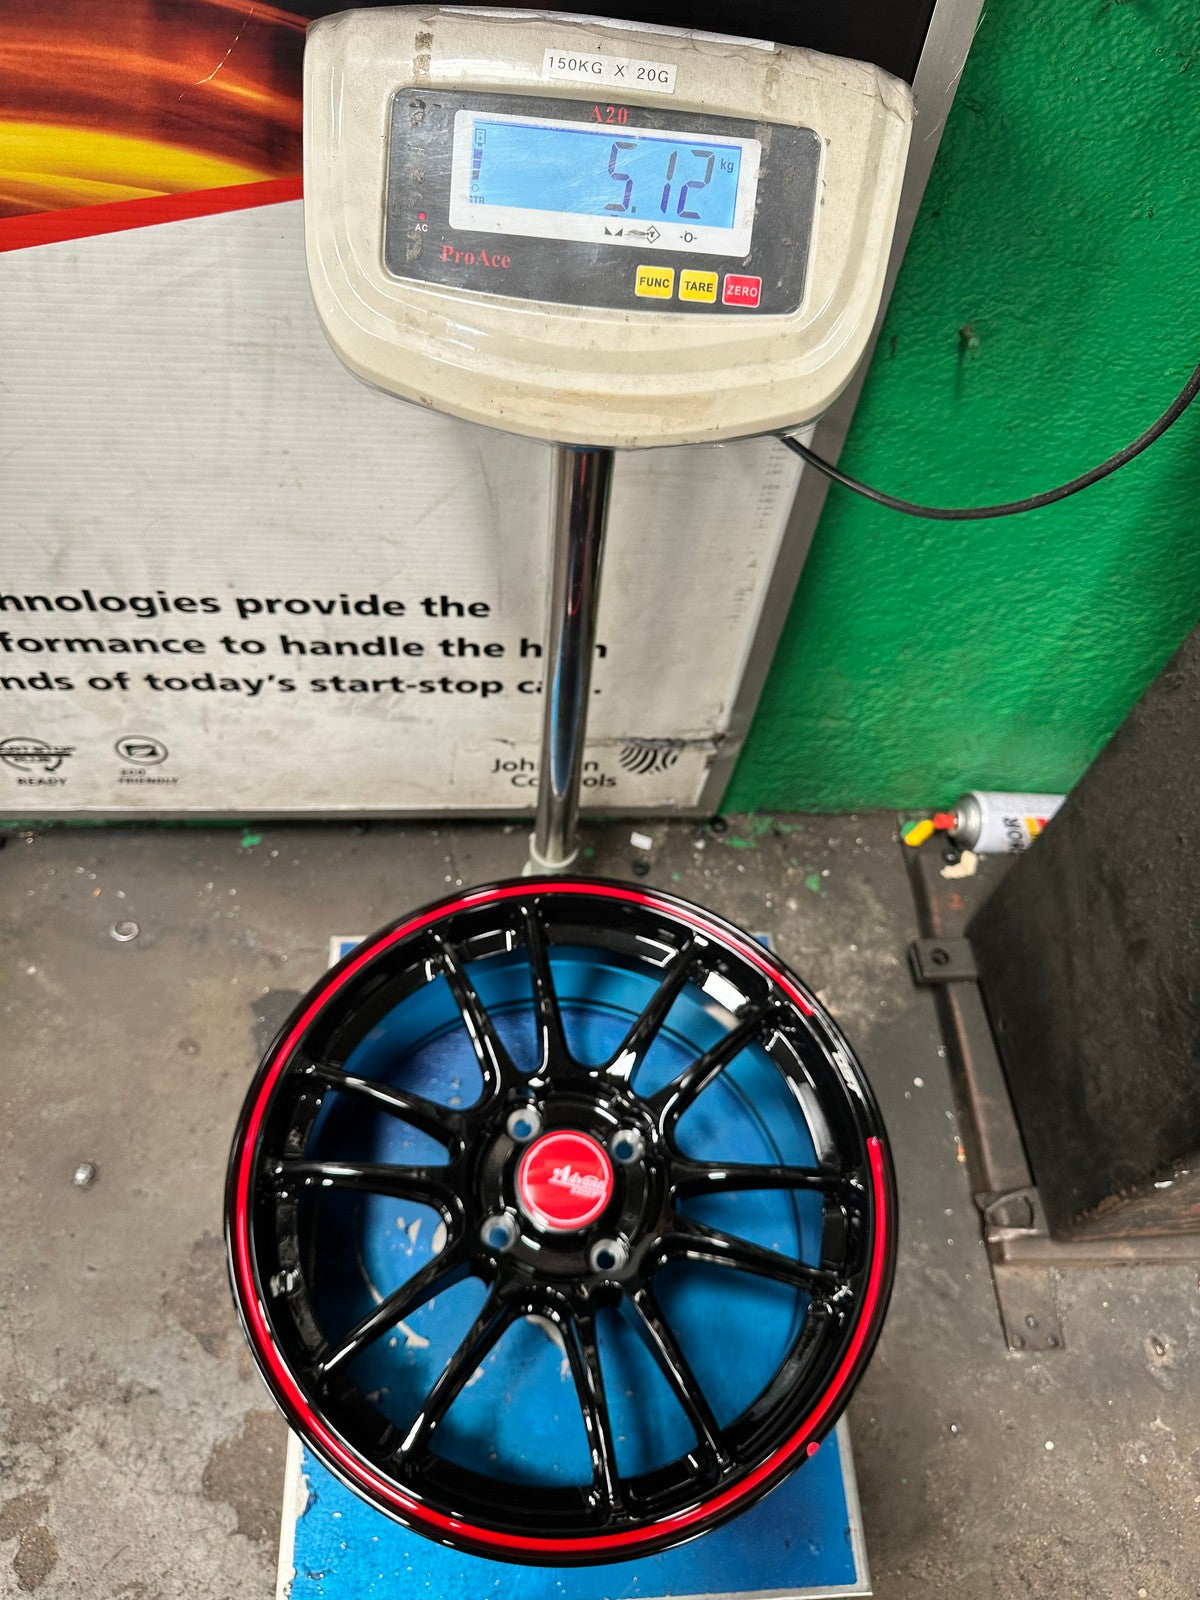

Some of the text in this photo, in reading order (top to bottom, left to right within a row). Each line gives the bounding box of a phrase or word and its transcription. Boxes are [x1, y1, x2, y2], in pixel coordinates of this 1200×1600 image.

[549, 56, 669, 83] 150KG X 20G
[589, 104, 628, 125] A20
[603, 141, 716, 220] 5.12
[414, 223, 429, 232] AC
[440, 244, 511, 269] ProAce
[639, 276, 758, 298] FUNC TARE ZERO
[236, 593, 406, 619] provide
[420, 595, 490, 617] the
[0, 631, 206, 653] formance
[219, 636, 265, 654] to
[279, 634, 424, 657] handle
[438, 637, 505, 657] the
[88, 671, 130, 690] of
[144, 672, 297, 697] today's
[310, 675, 503, 698] start-stop
